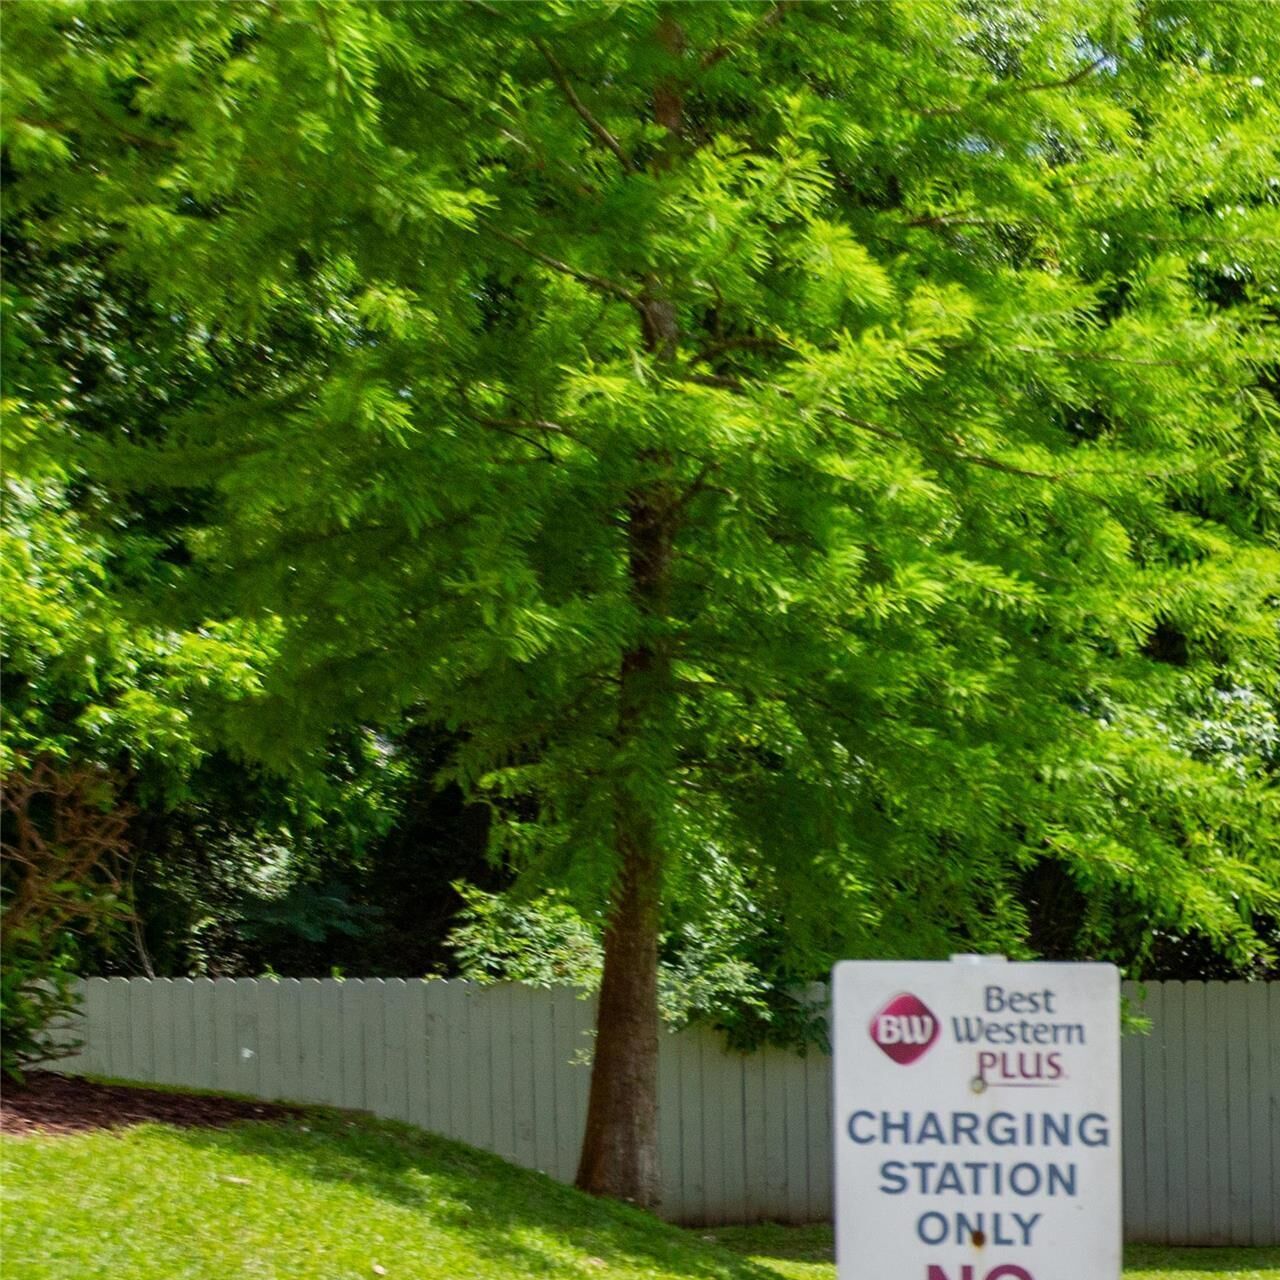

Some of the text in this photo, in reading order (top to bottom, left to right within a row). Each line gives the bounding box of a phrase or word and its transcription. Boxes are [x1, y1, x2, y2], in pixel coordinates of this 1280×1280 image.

[984, 985, 1055, 1013] Best
[877, 1014, 933, 1044] BW
[952, 1016, 1085, 1044] Western
[978, 1052, 1064, 1079] PLUS
[847, 1110, 1110, 1147] CHARGING
[880, 1161, 1077, 1196] STATION
[916, 1211, 1041, 1246] ONLY
